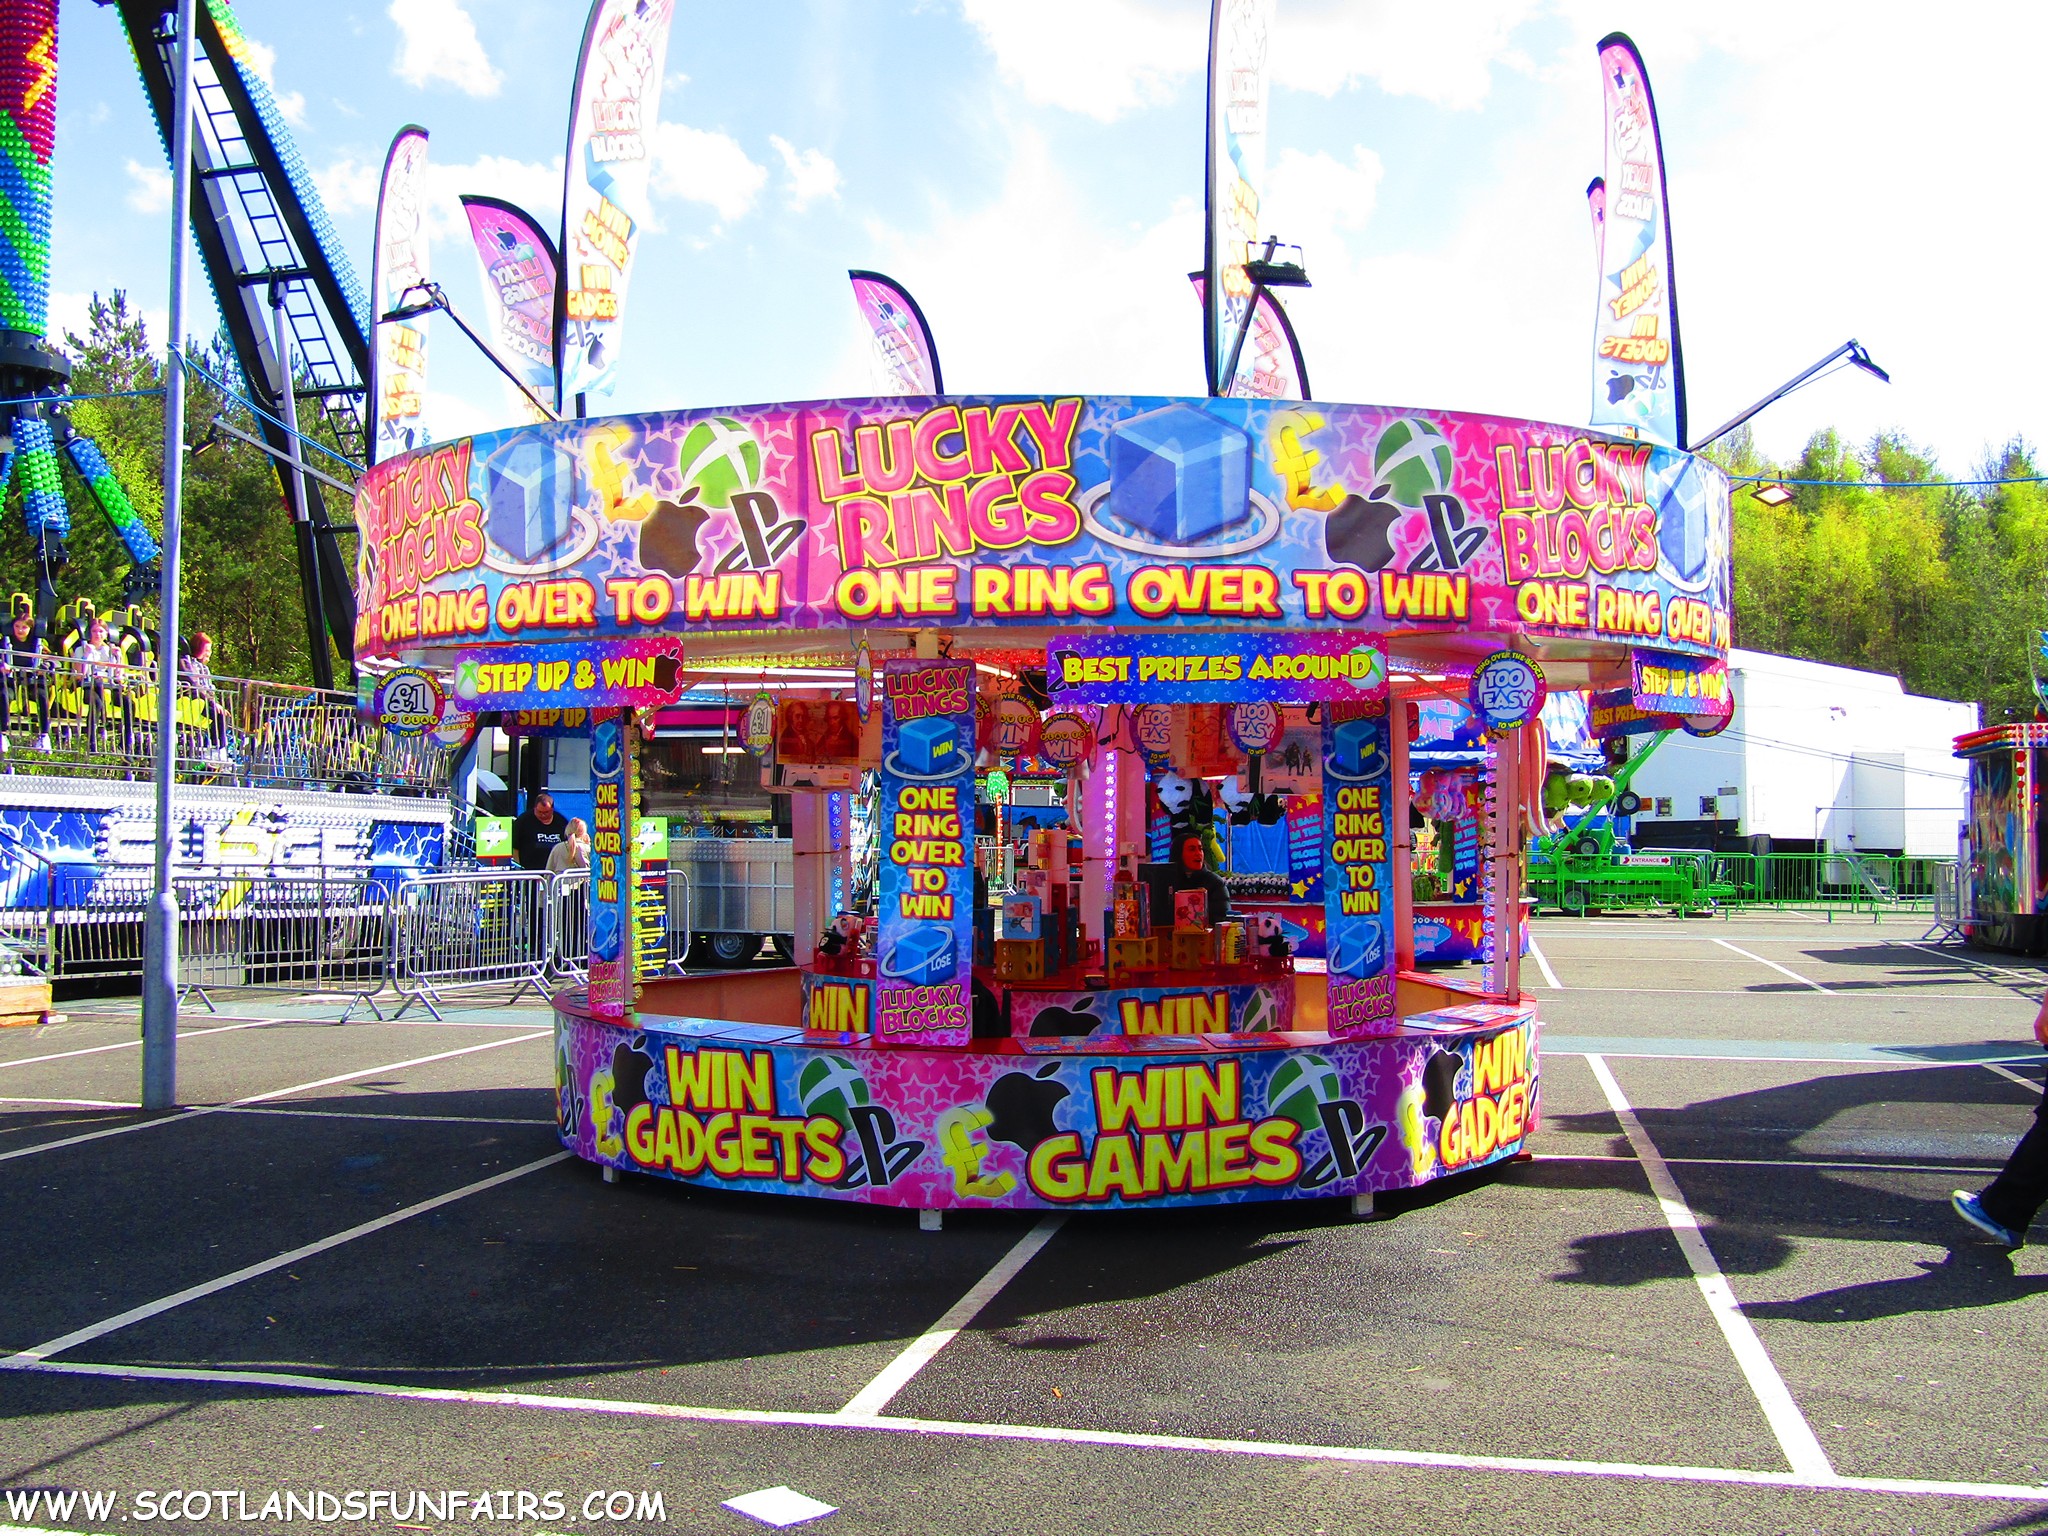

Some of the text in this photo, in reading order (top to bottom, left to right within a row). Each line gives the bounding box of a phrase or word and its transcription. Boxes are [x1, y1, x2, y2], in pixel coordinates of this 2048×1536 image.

[810, 396, 1083, 502] LUCKY
[378, 437, 472, 538] LUCKY
[1495, 438, 1653, 511] LUCKY
[835, 470, 1083, 569] RINGS
[378, 499, 485, 604] BLOCKS
[1498, 503, 1659, 586] BLOCKS
[835, 564, 1471, 623] ONE RING OVER TO WIN
[381, 570, 783, 645] ONE RING OVER TO WIN
[1516, 580, 1713, 646] ONE RING OVER
[477, 656, 656, 694] STEP UP & WIN
[1063, 653, 1373, 683] BEST PRIZES AROUND
[1475, 660, 1491, 675] RING
[1491, 652, 1510, 661] OVER
[1512, 653, 1525, 661] THE
[1525, 659, 1544, 679] BLOCK
[1485, 668, 1525, 688] TOO
[380, 673, 396, 686] RING
[396, 668, 414, 676] OVER
[415, 669, 427, 679] THE
[427, 676, 443, 695] BLOCK
[885, 664, 970, 702] LUCKY
[1641, 665, 1722, 699] STEP UP & WIN
[387, 683, 428, 713] £1
[893, 689, 970, 720] RINGS
[1238, 702, 1269, 721] TOO
[1330, 699, 1385, 723] RINGS
[1482, 689, 1535, 710] EASY
[380, 714, 439, 725] TO PLAY
[518, 707, 587, 728] STEP UP
[1236, 721, 1276, 739] EASY
[1508, 719, 1523, 728] WIN
[1594, 707, 1613, 727] BEST
[409, 729, 423, 737] WIN
[1071, 730, 1086, 738] TO
[1140, 727, 1171, 744] EAS
[932, 740, 954, 758] WIN
[1044, 738, 1085, 758] WIN
[1360, 741, 1376, 760] WIN
[596, 783, 618, 807] ONE
[899, 786, 957, 811] ONE
[1335, 786, 1380, 811] ONE
[595, 808, 620, 832] RING
[894, 813, 960, 839] RING
[1333, 811, 1384, 837] RING
[594, 831, 621, 856] OVER
[890, 839, 964, 866] OVER
[1331, 837, 1386, 863] OVER
[600, 855, 616, 879] TO
[908, 866, 946, 893] TO
[1346, 865, 1374, 889] TO
[597, 879, 618, 903] WIN
[1341, 889, 1380, 916] WIN
[901, 894, 953, 921] WIN
[930, 953, 952, 973] LOSE
[1365, 945, 1381, 966] LOSE
[588, 961, 623, 983] LUCKY
[588, 977, 624, 1003] BLOCKS
[882, 984, 961, 1011] LUCKY
[1331, 974, 1390, 1001] LUCKY
[810, 983, 869, 1033] WIN
[882, 1003, 968, 1034] BLOCKS
[1118, 992, 1229, 1035] WIN
[1332, 994, 1394, 1031] BLOCKS
[1473, 1024, 1527, 1096] WIN
[664, 1044, 777, 1115] WIN
[1093, 1060, 1242, 1135] WIN
[624, 1100, 847, 1184] GADGETS
[1026, 1116, 1302, 1203] GAMES
